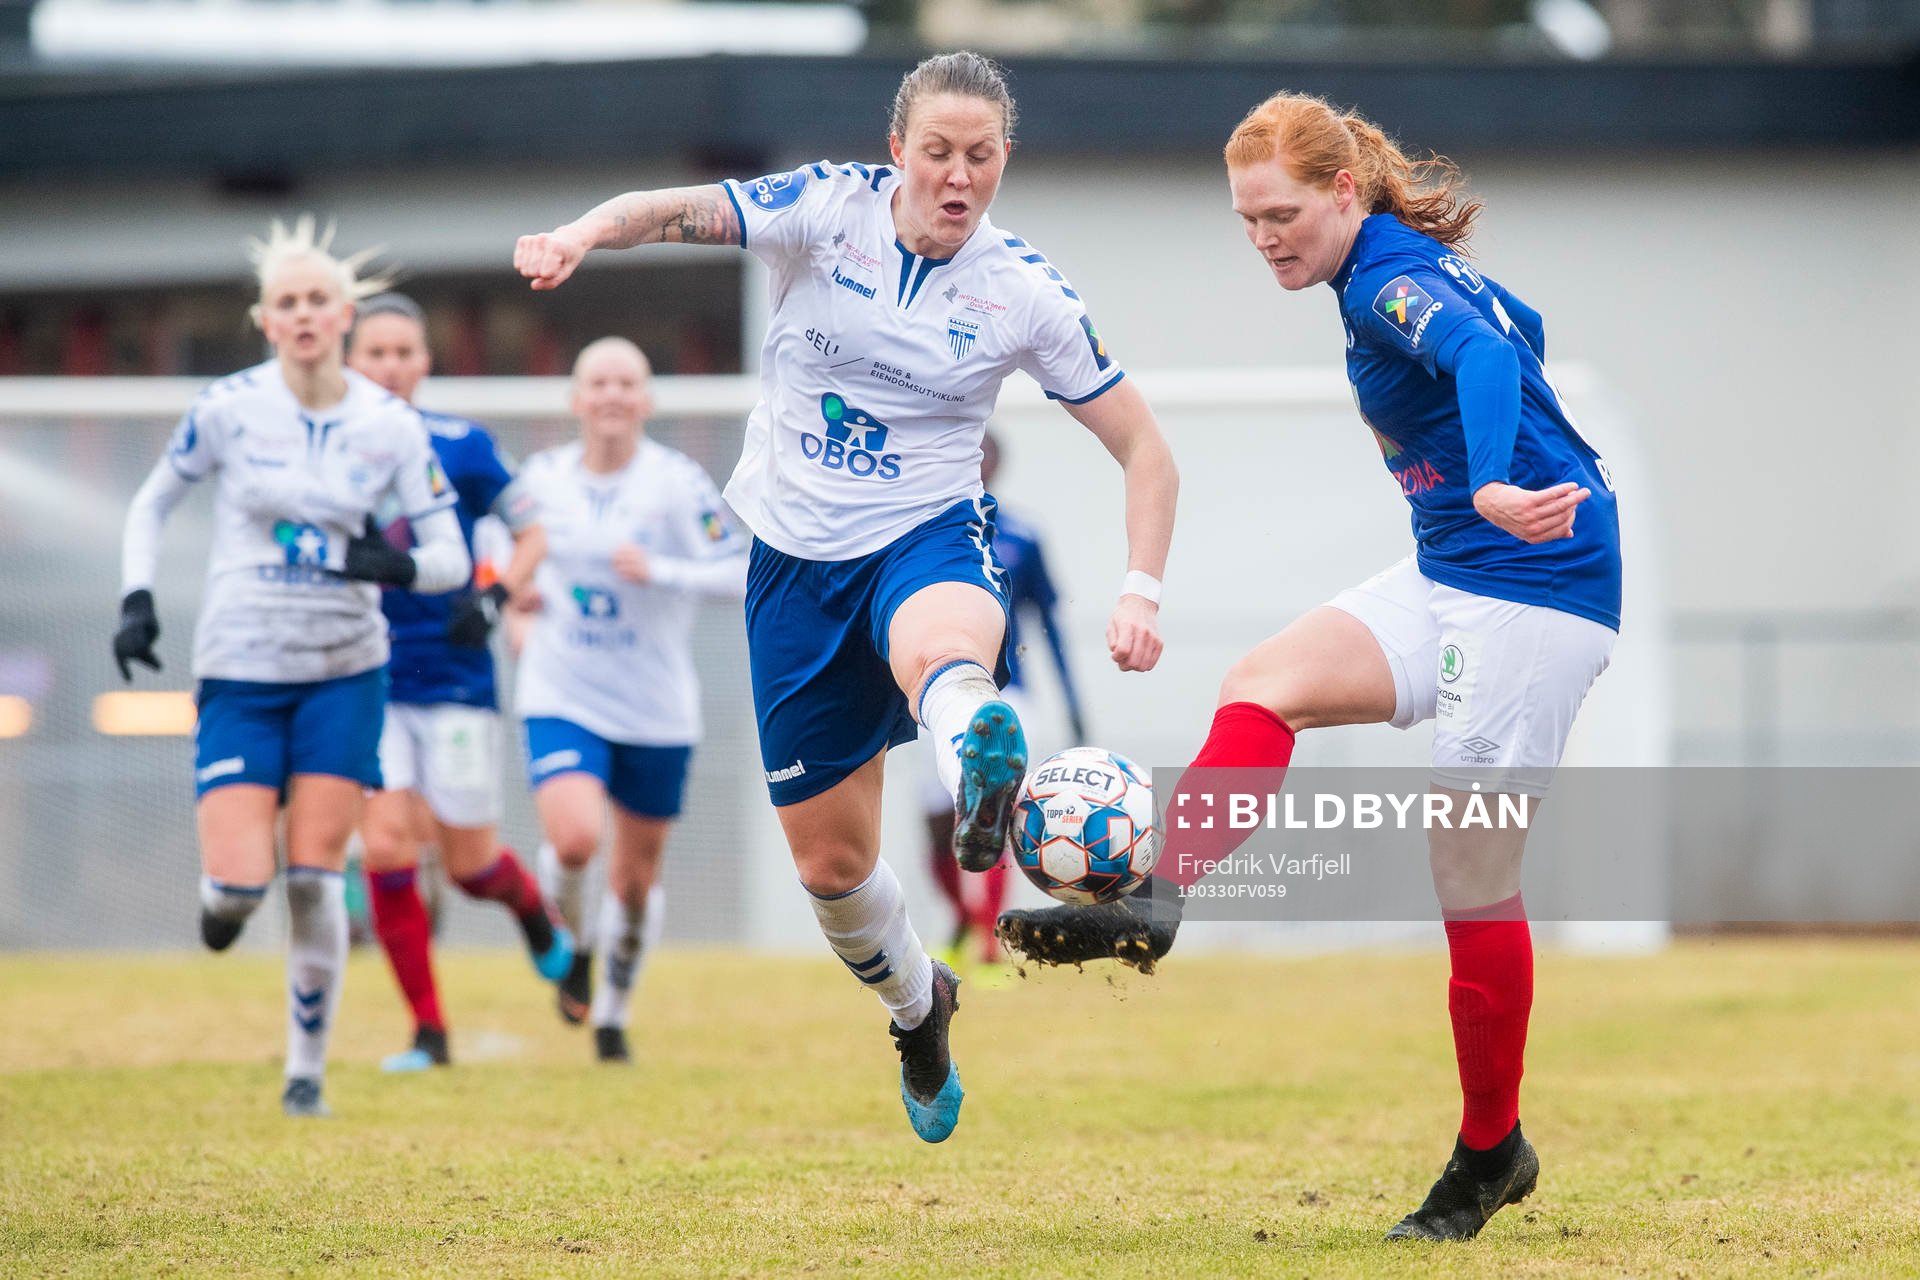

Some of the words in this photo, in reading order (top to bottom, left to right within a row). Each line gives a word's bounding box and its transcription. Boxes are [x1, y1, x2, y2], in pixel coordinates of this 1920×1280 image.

[831, 265, 877, 300] hummel
[1411, 301, 1443, 349] umbro
[873, 361, 902, 376] BOLIG
[905, 371, 912, 380] &
[870, 369, 966, 402] EIENDOMSUTVIKLING
[800, 432, 902, 480] OBOS
[765, 759, 806, 783] ummel
[1460, 753, 1495, 765] umbro
[1035, 766, 1116, 791] SELECT
[1046, 809, 1063, 819] TOPP
[1062, 815, 1083, 824] SERIEN
